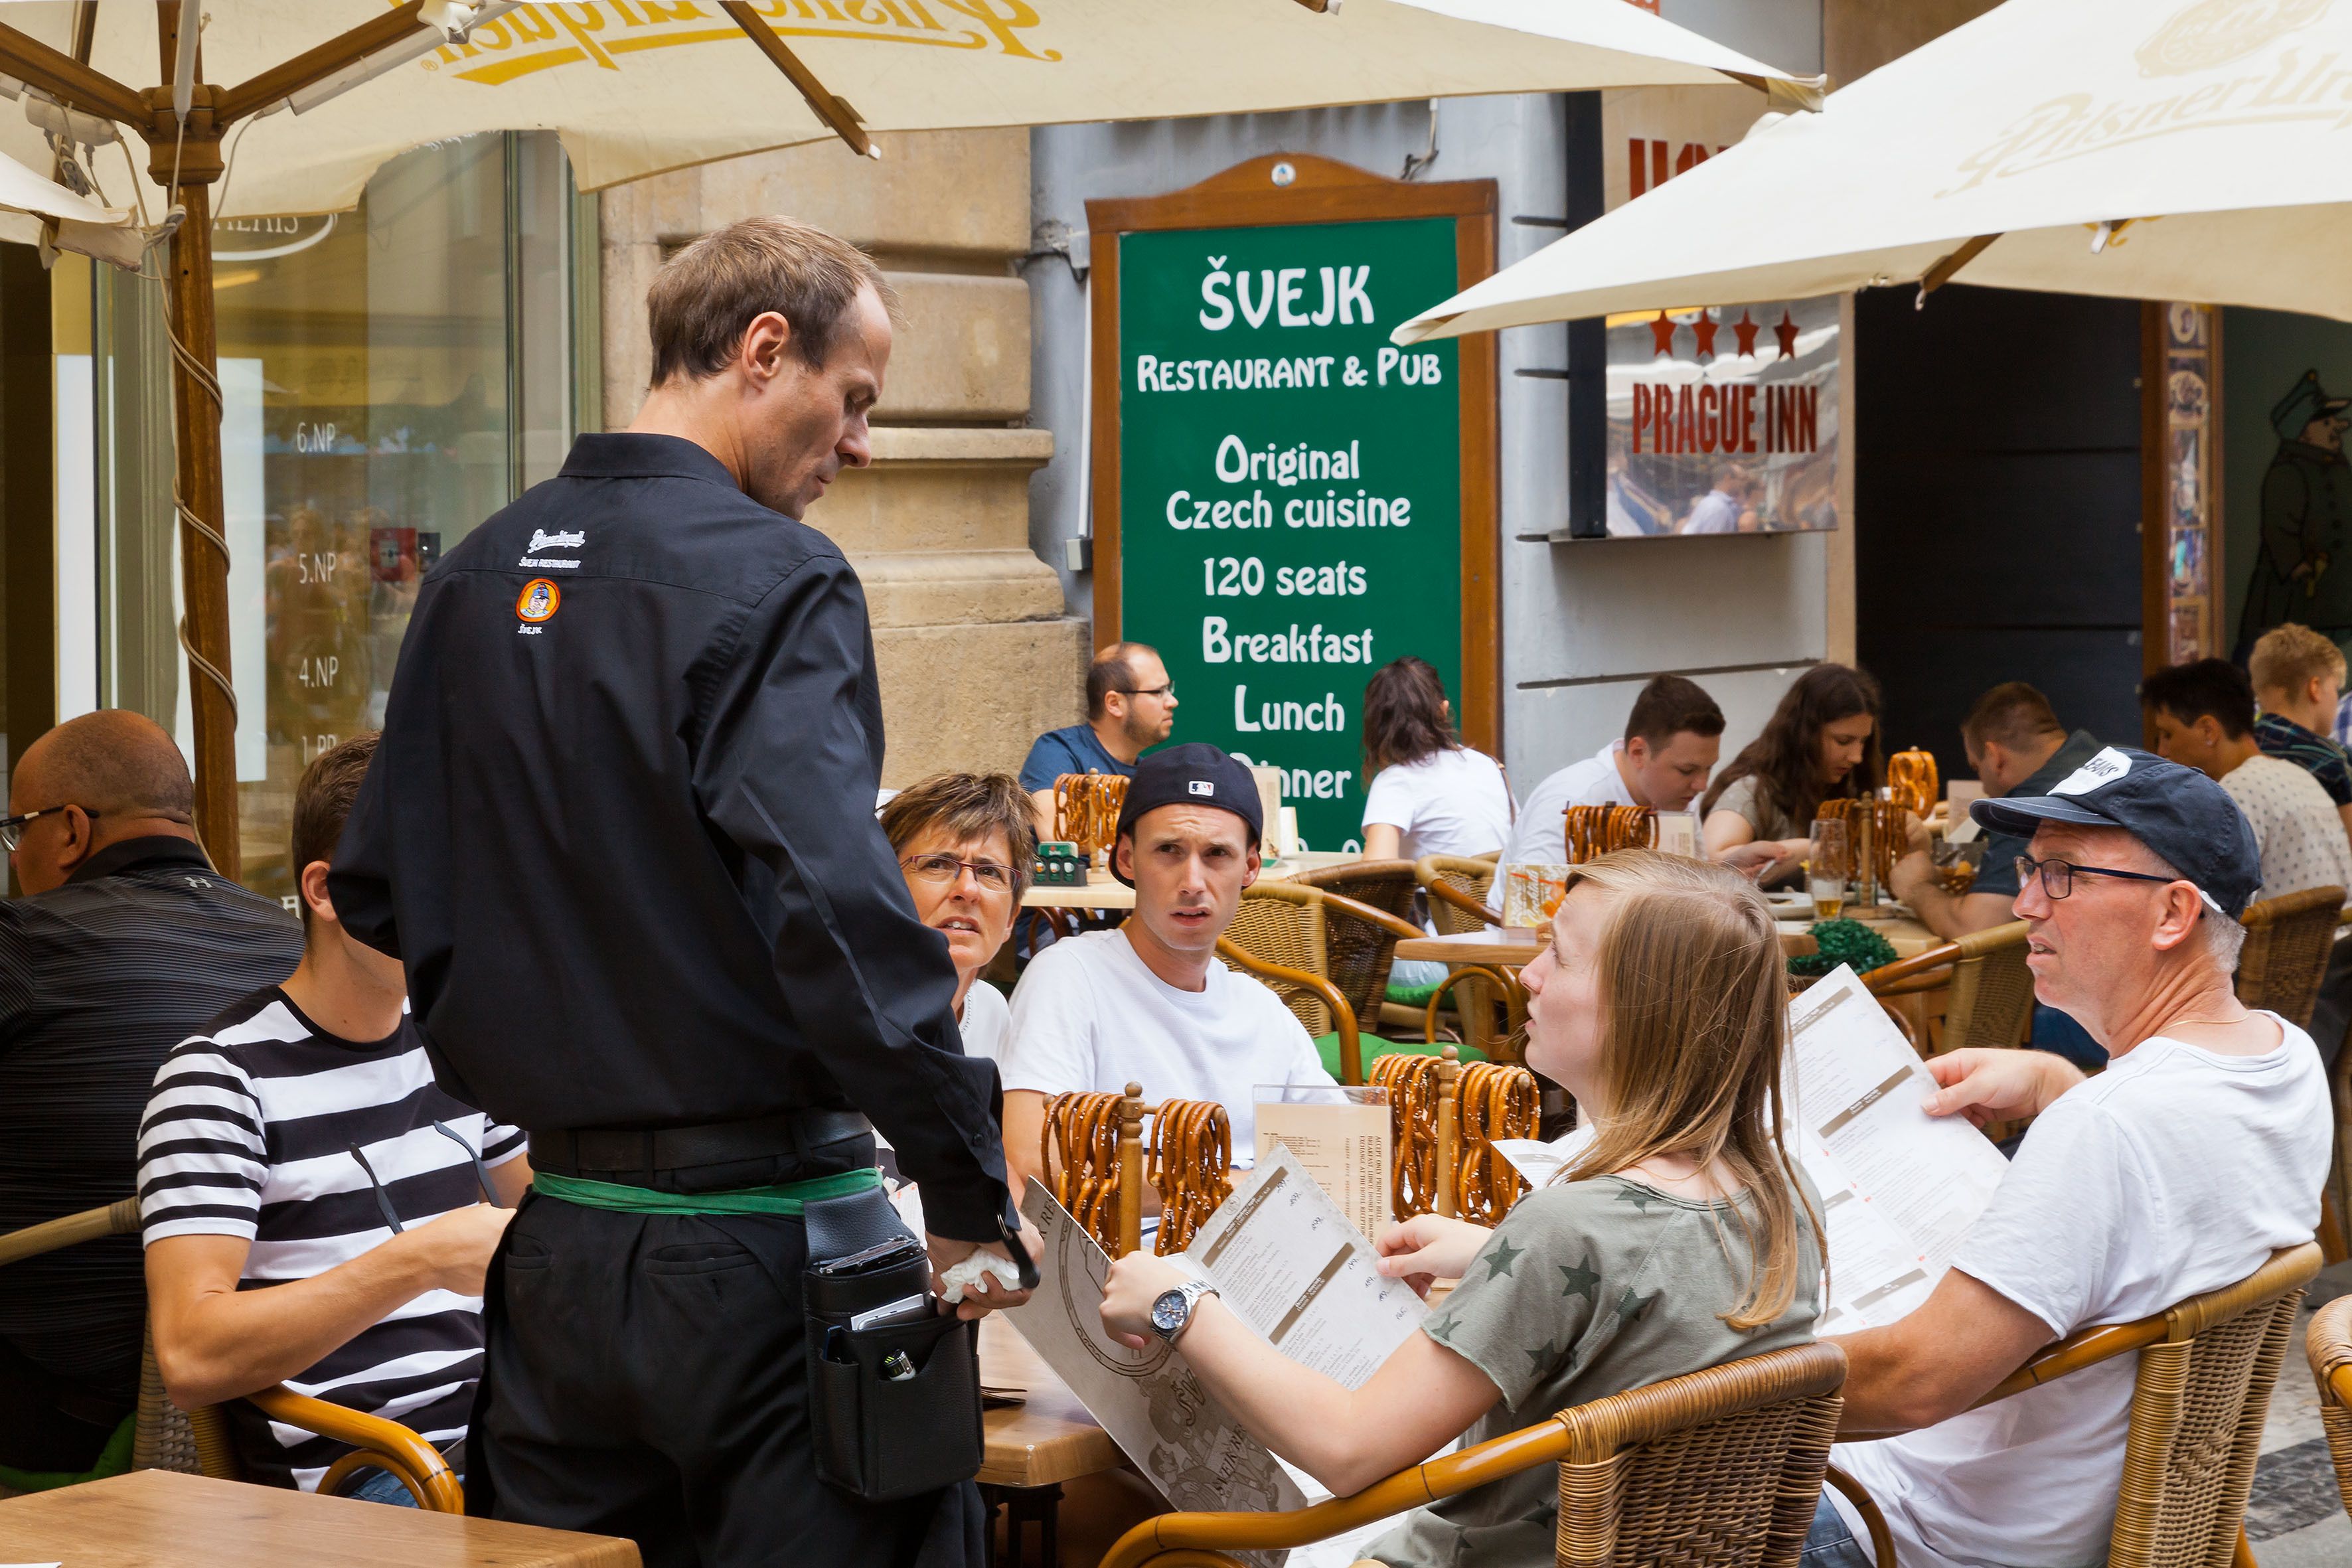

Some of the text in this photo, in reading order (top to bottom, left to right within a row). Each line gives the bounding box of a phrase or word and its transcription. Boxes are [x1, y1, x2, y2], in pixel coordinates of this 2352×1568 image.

[1933, 75, 2267, 199] Pilsner
[1199, 255, 1375, 331] ŠVEJK
[1137, 347, 1442, 392] RESTAURANT & PUB
[296, 422, 336, 453] 6.NP
[1632, 382, 1817, 453] PRAGUE INN
[1215, 434, 1360, 487] Original
[1166, 489, 1411, 530] Czech cuisine
[299, 552, 337, 584] 5.NP
[1204, 556, 1368, 596] 120 seats
[1202, 616, 1373, 664] Breakfast
[299, 656, 339, 688] 4.NP
[1234, 684, 1345, 732] Lunch
[1229, 752, 1352, 799] nner
